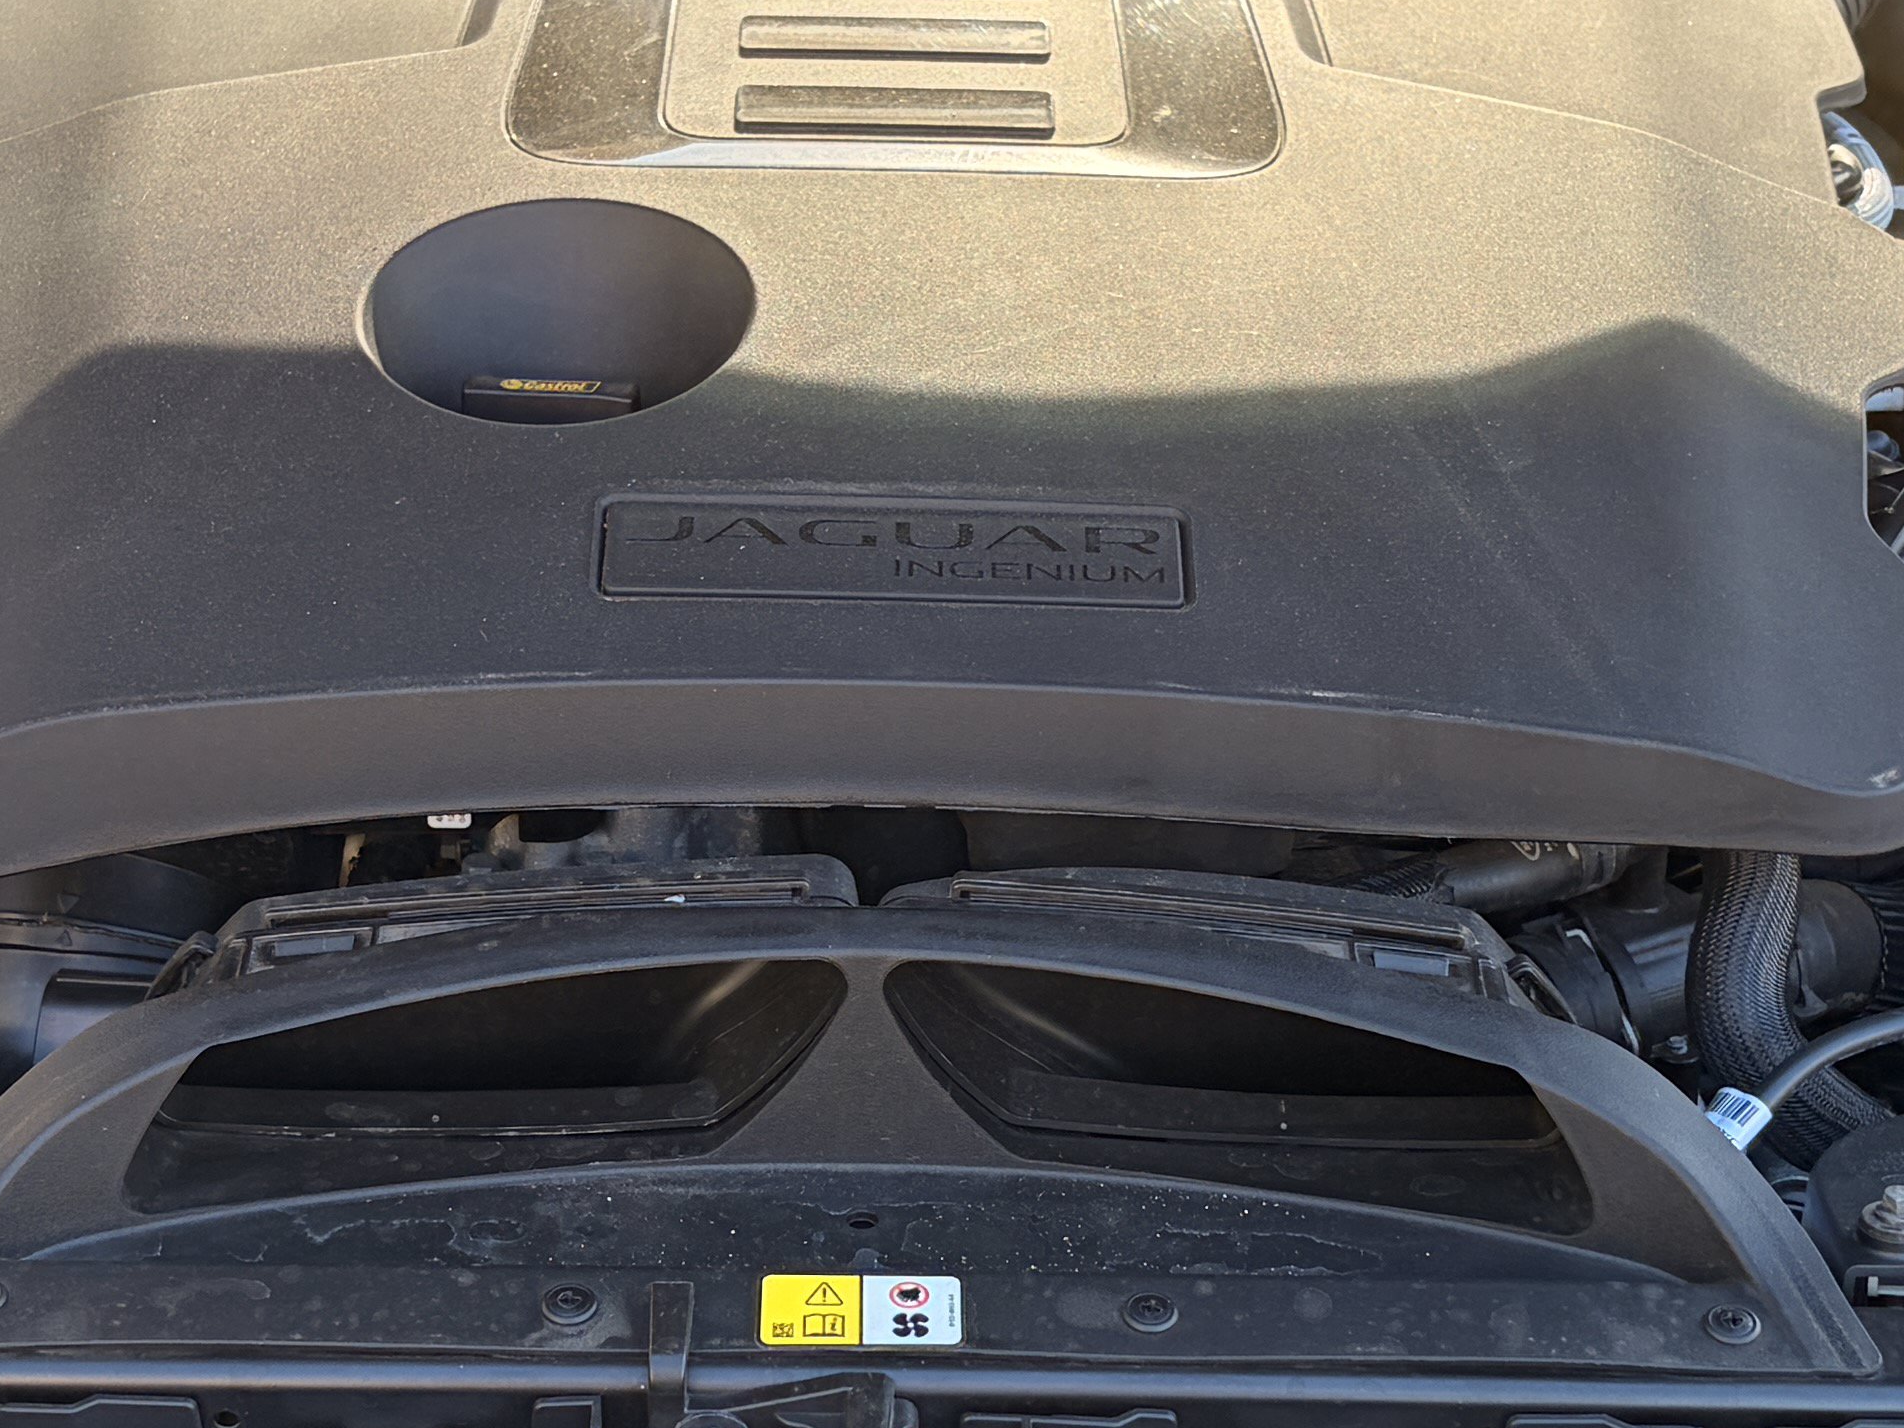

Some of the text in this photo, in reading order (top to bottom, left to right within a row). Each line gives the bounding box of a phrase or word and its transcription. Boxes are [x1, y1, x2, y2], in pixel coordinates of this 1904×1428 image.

[523, 379, 588, 393] Castrol
[625, 515, 1162, 556] JAGUAR
[894, 559, 1166, 585] INGENIUM
